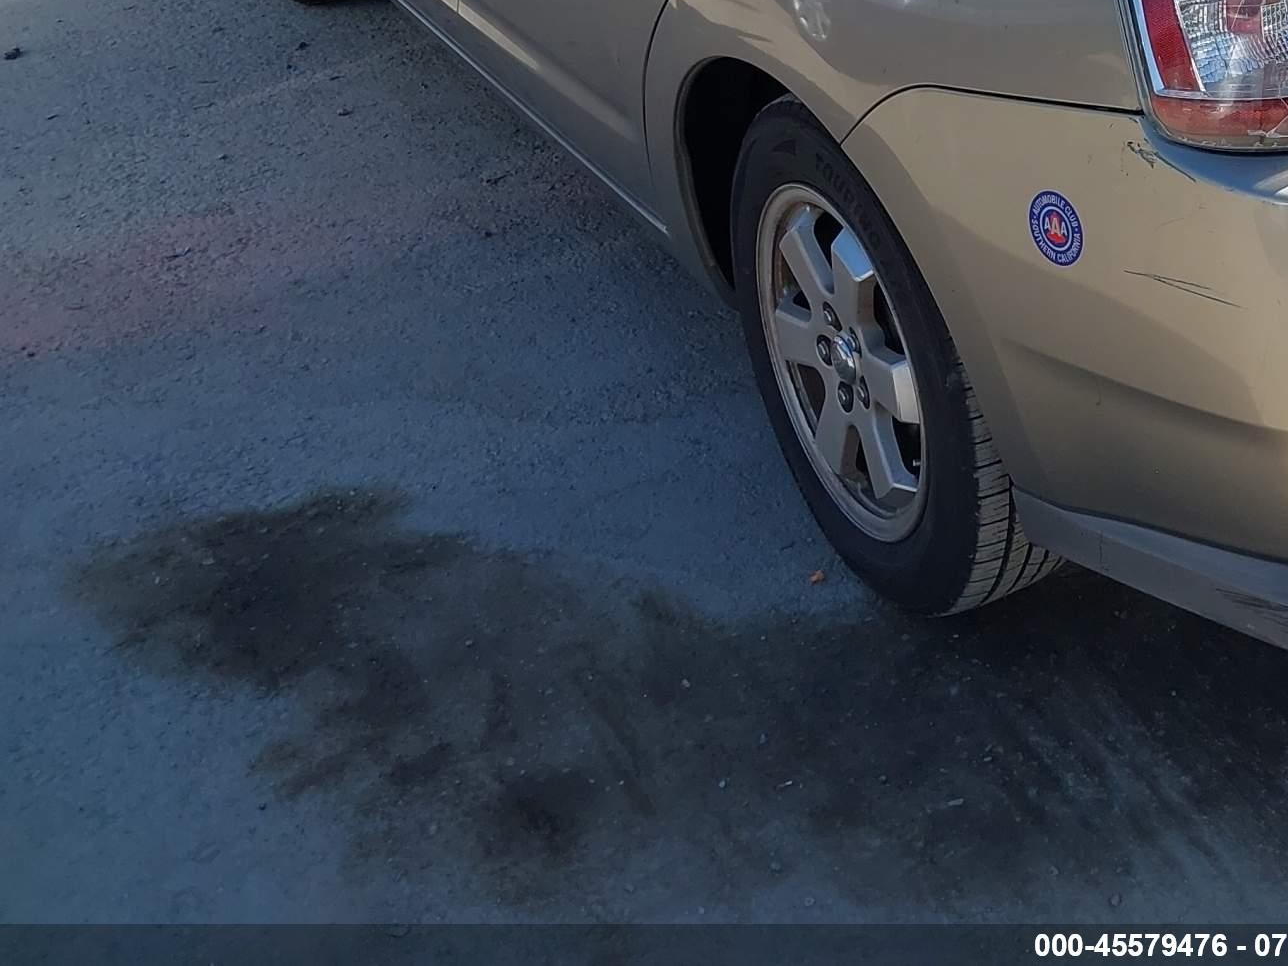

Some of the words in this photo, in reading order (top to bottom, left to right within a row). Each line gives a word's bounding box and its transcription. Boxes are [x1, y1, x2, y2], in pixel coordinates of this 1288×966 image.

[1032, 194, 1066, 217] AUTOMOBILE
[1044, 217, 1068, 237] AAA
[1031, 219, 1056, 261] SOUTHERN
[1057, 233, 1081, 263] CALIFORNIA
